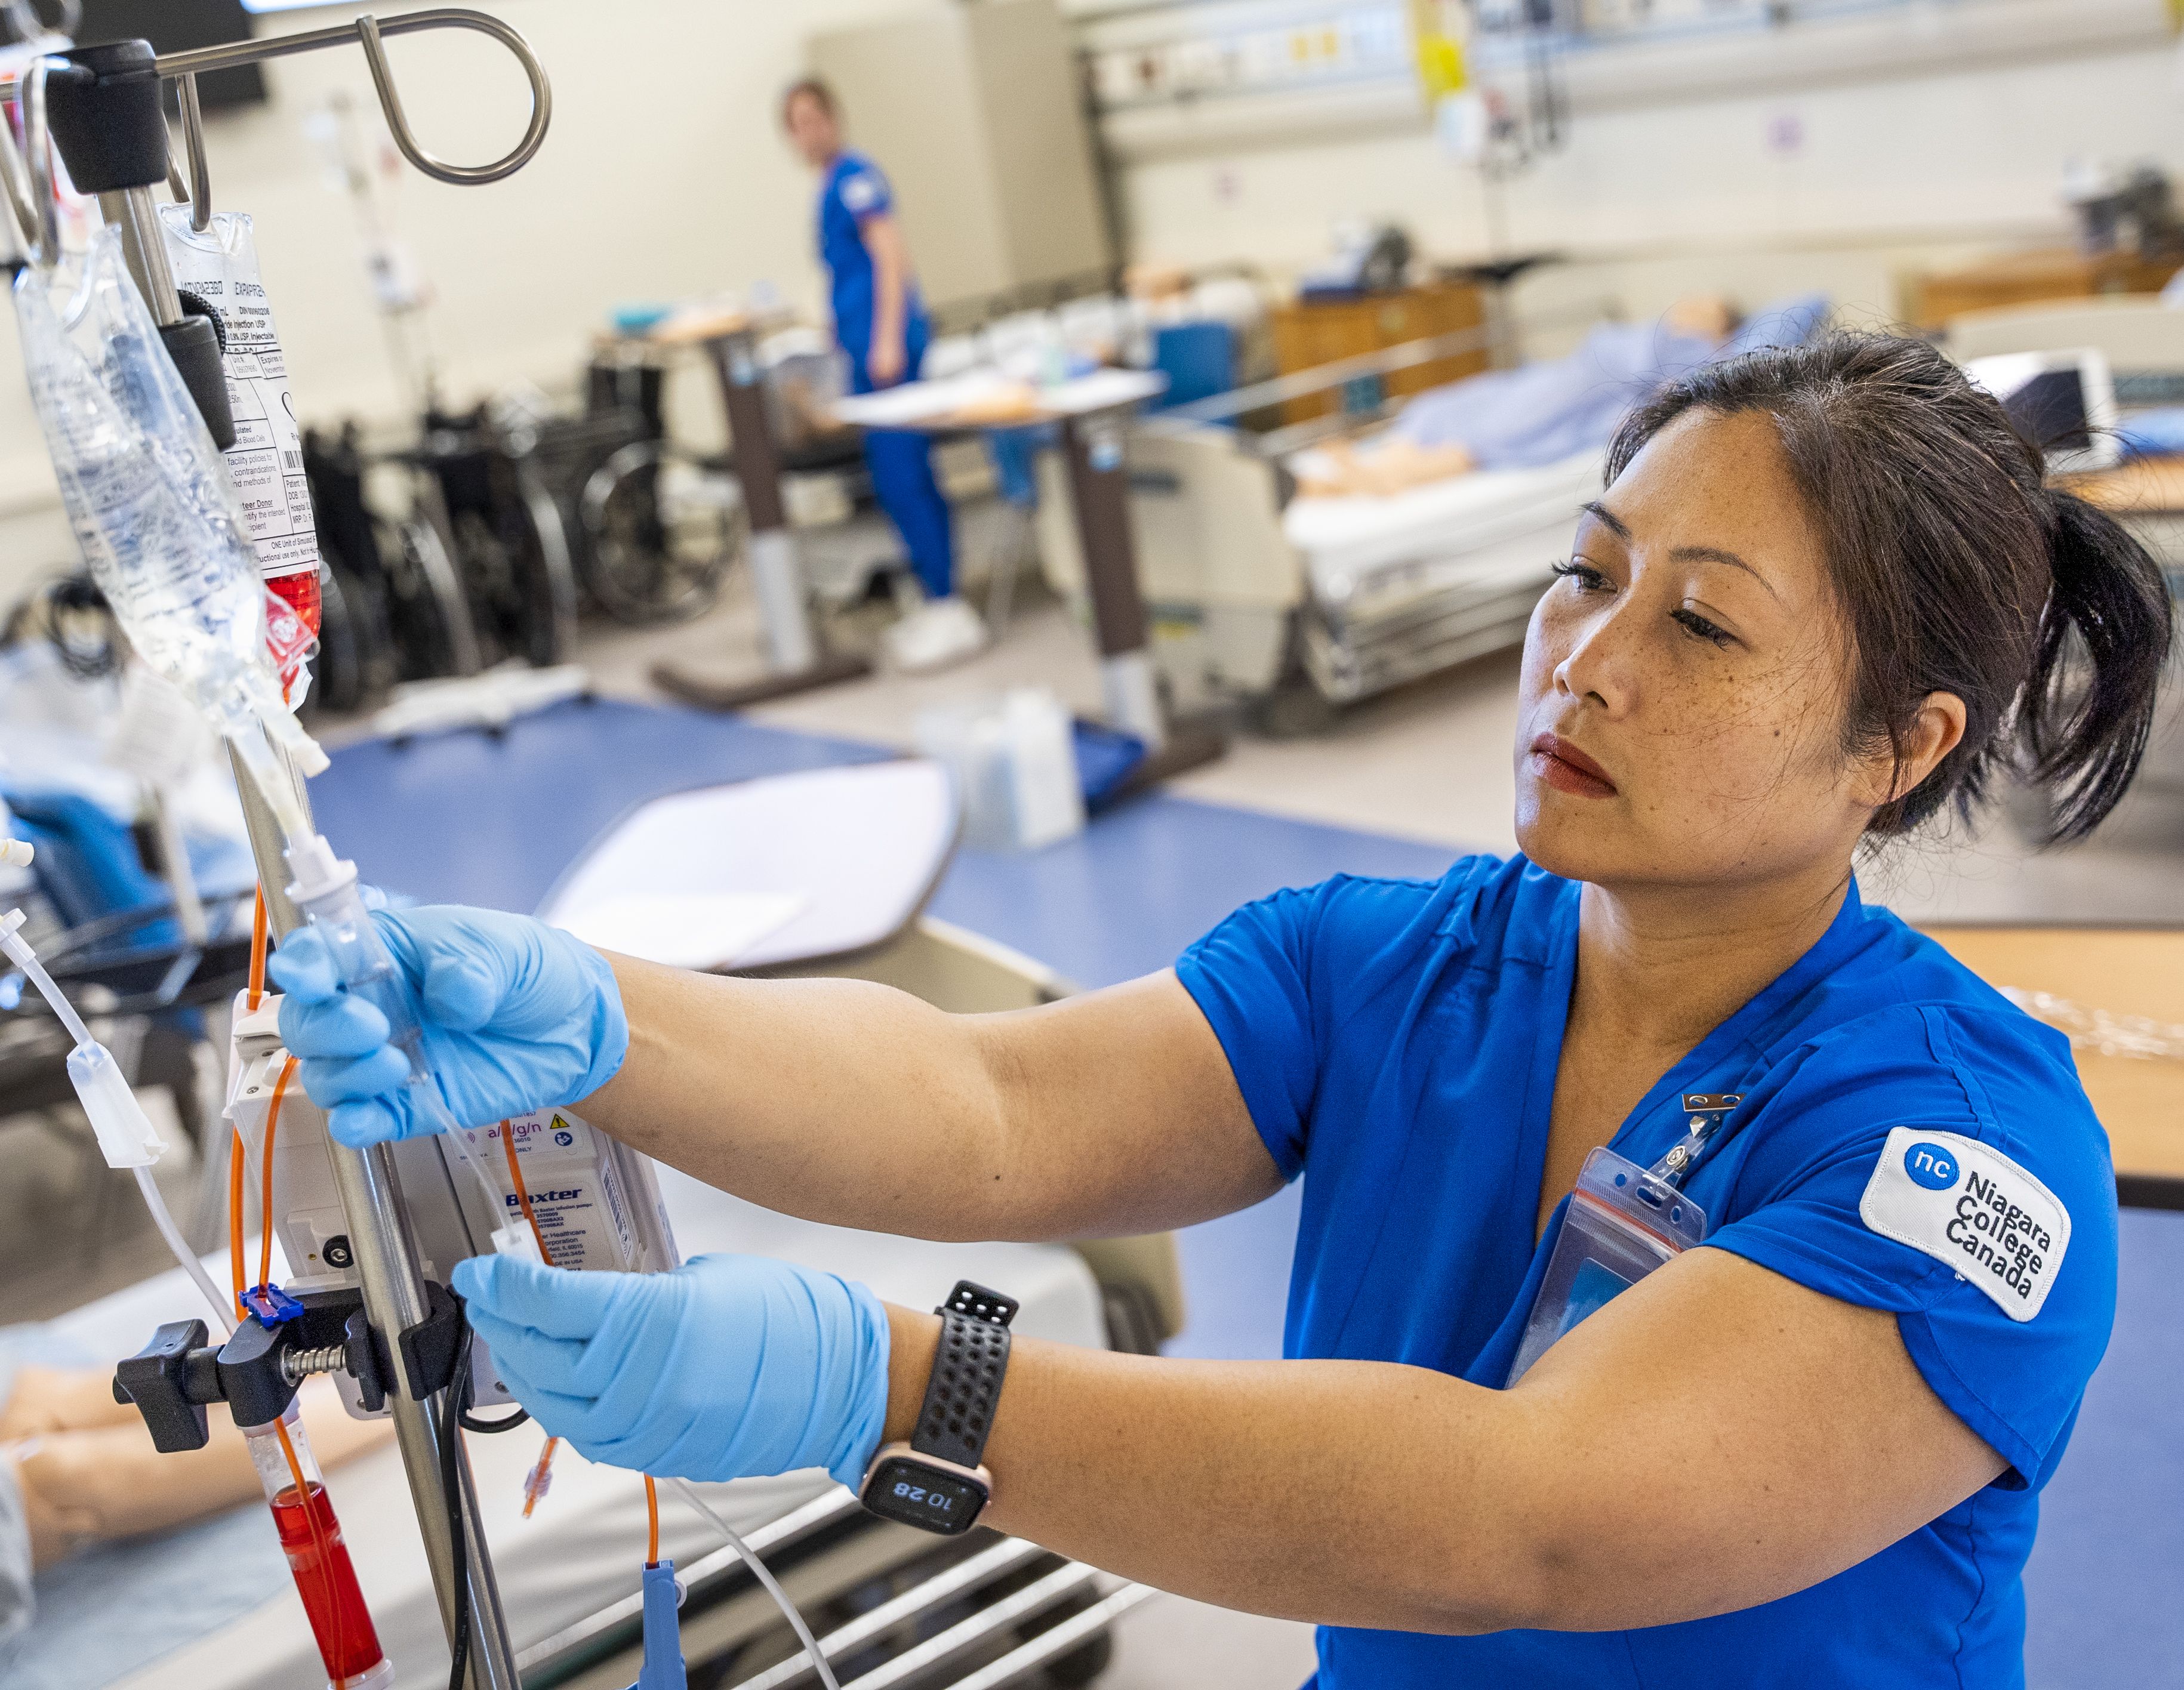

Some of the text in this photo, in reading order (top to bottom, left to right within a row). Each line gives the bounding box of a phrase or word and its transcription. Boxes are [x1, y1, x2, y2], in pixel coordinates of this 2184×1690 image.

[233, 320, 254, 330] Injection
[260, 356, 279, 365] Expires
[227, 457, 248, 465] facility
[244, 476, 266, 486] methods
[257, 499, 273, 508] Donor
[488, 1122, 541, 1138] a//g/n
[1914, 1151, 1951, 1178] nc
[1965, 1170, 2050, 1253] Niagara
[550, 1229, 586, 1238] Healthcare
[1956, 1195, 2042, 1275] College
[1946, 1218, 2032, 1299] Canada
